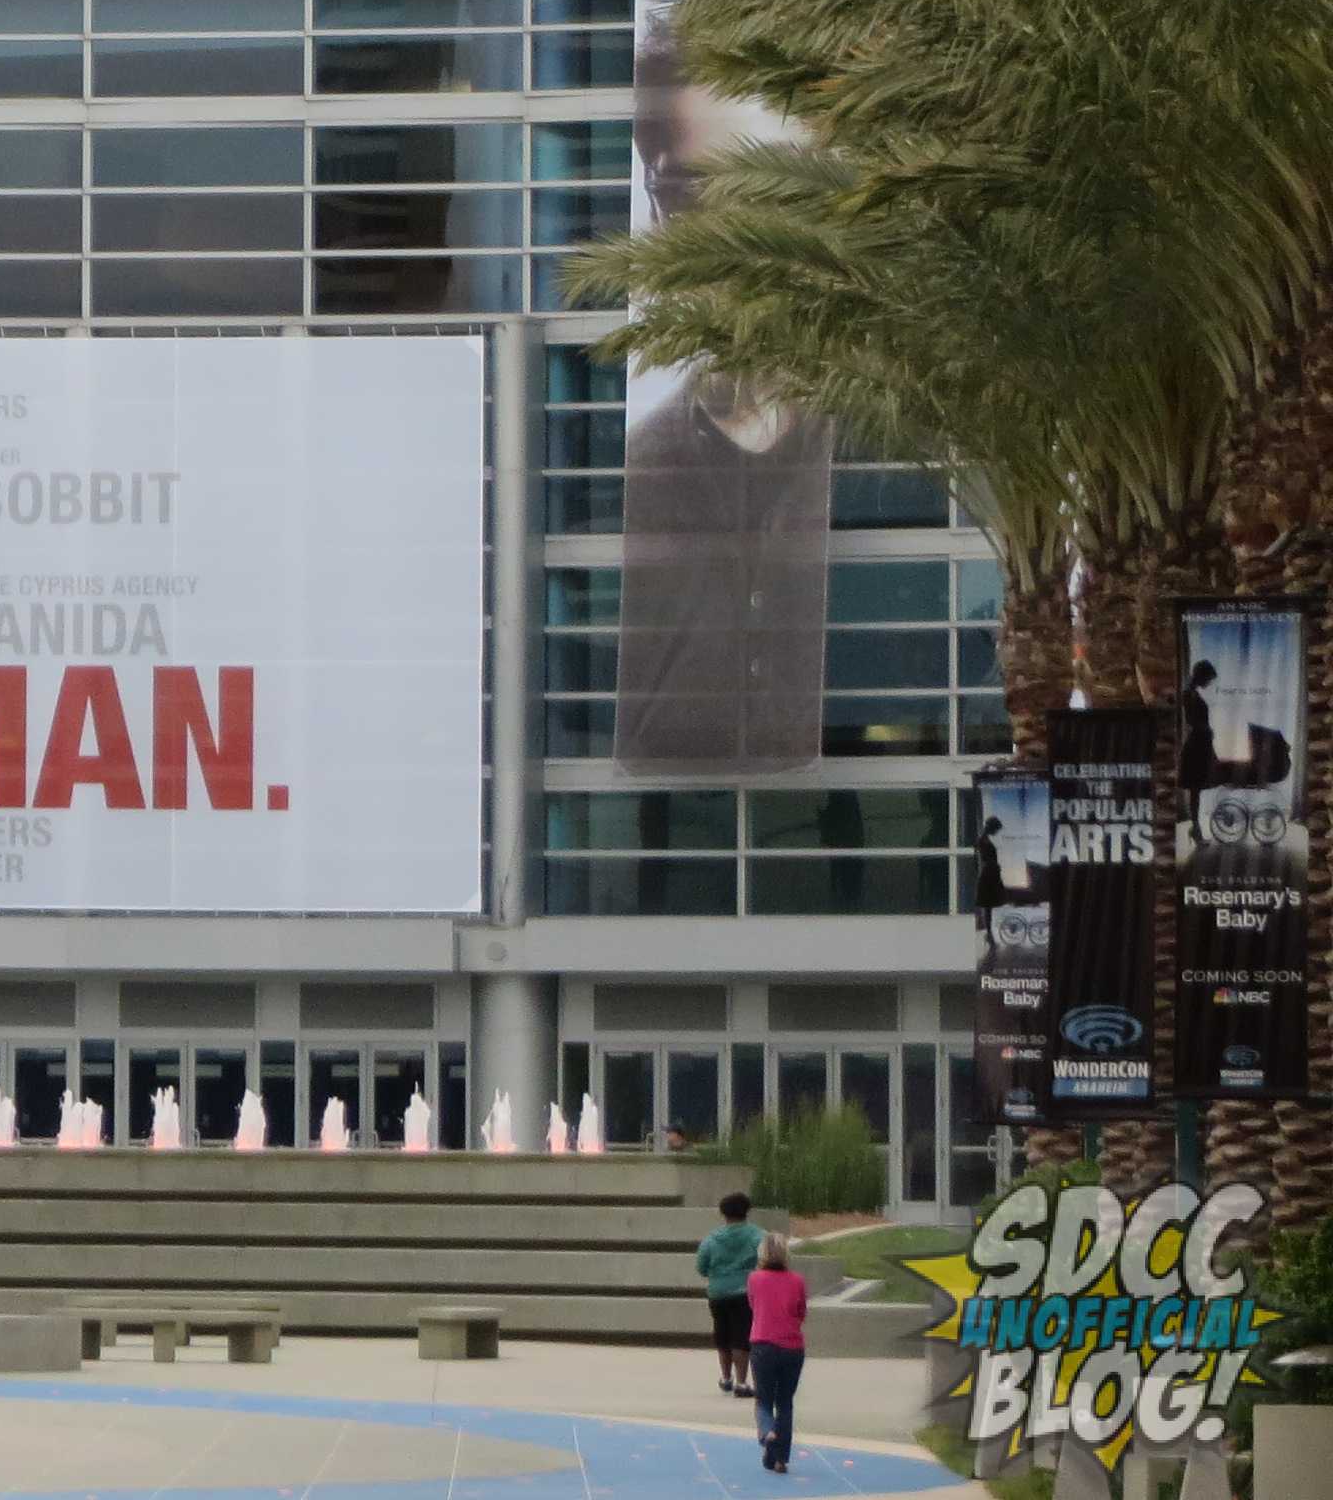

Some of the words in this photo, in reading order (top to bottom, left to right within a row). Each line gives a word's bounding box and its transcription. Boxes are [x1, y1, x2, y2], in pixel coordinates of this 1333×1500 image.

[18, 574, 106, 597] CYPRUS
[113, 574, 201, 597] AGENCY
[1086, 781, 1112, 796] THE
[1053, 798, 1153, 821] POPULAR
[1051, 823, 1155, 863] ARTS
[1183, 886, 1301, 910] Rosemary's
[1216, 908, 1268, 932] Baby
[1181, 969, 1250, 983] COMING
[1252, 969, 1302, 983] SOON
[1003, 991, 1041, 1009] Baby
[1237, 991, 1271, 1005] NBC
[978, 1033, 1028, 1045] COMING
